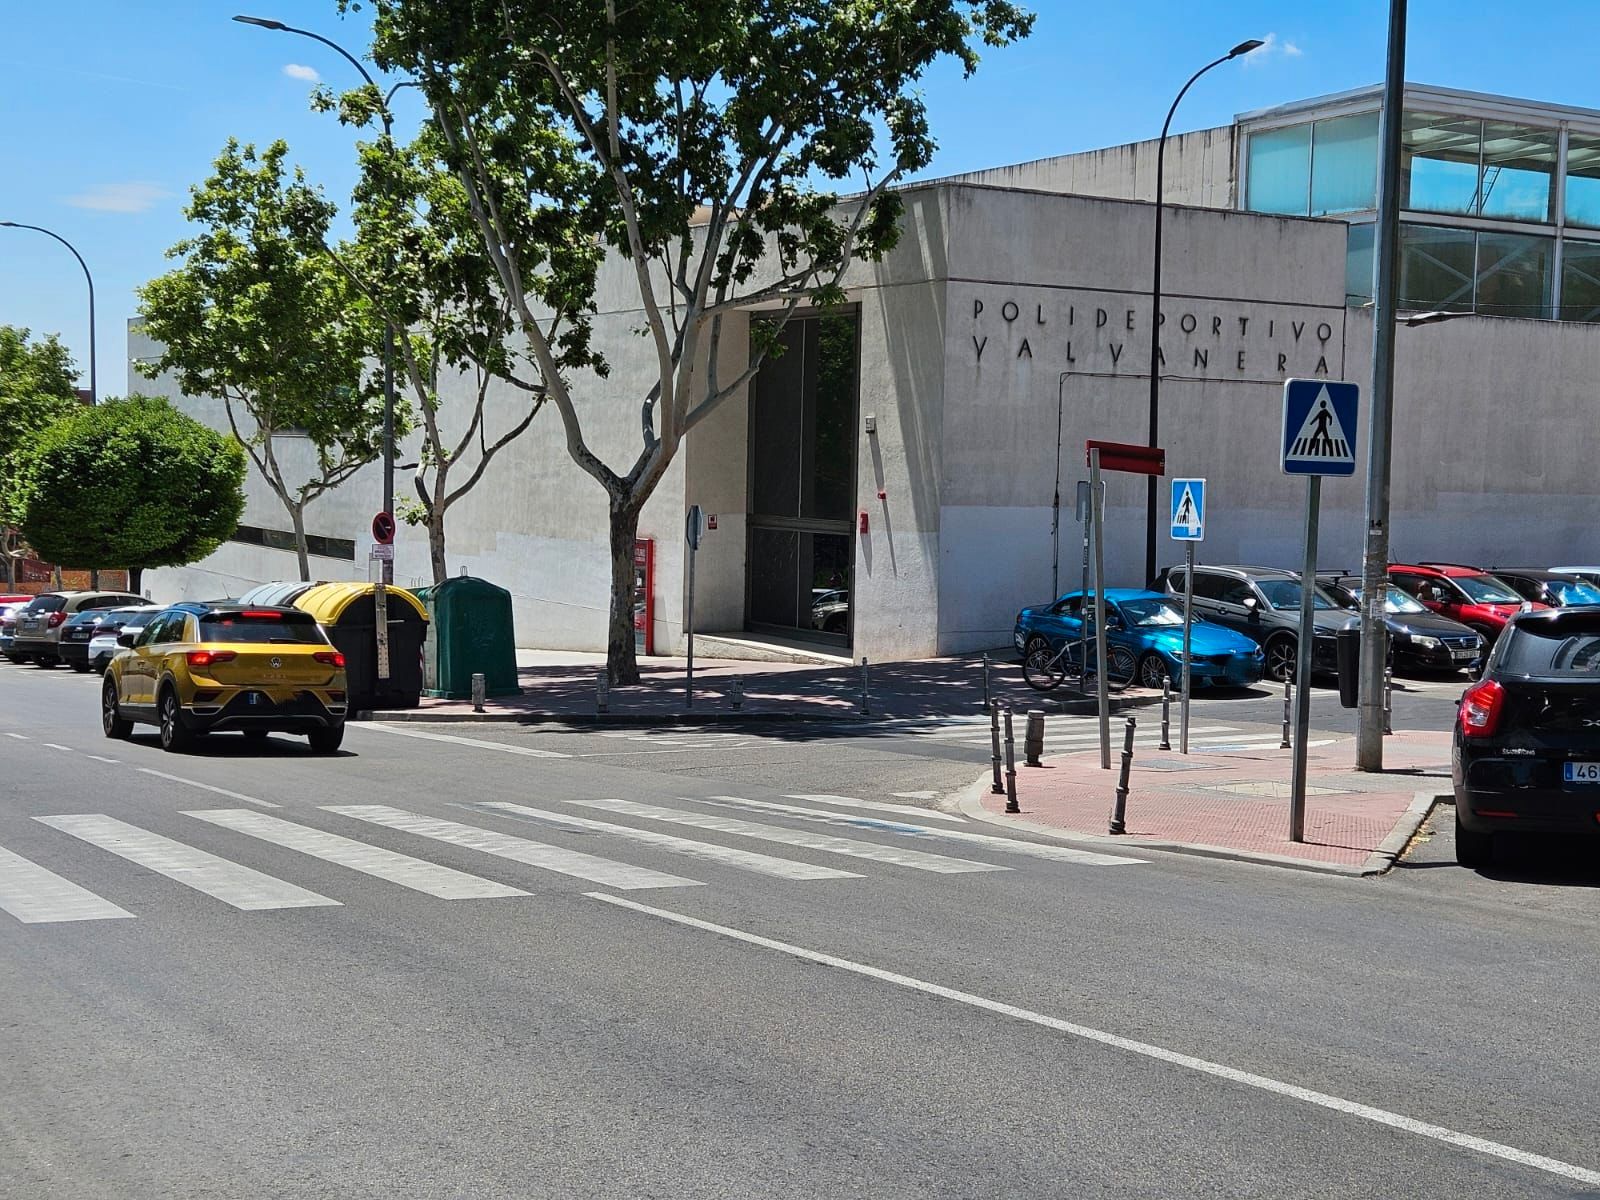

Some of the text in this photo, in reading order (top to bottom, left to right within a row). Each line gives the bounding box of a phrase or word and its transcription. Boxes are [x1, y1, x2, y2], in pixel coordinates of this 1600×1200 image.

[974, 299, 1332, 342] POLIDEPORTIVO
[973, 335, 1329, 374] VALVANERA
[1577, 764, 1600, 779] 46
